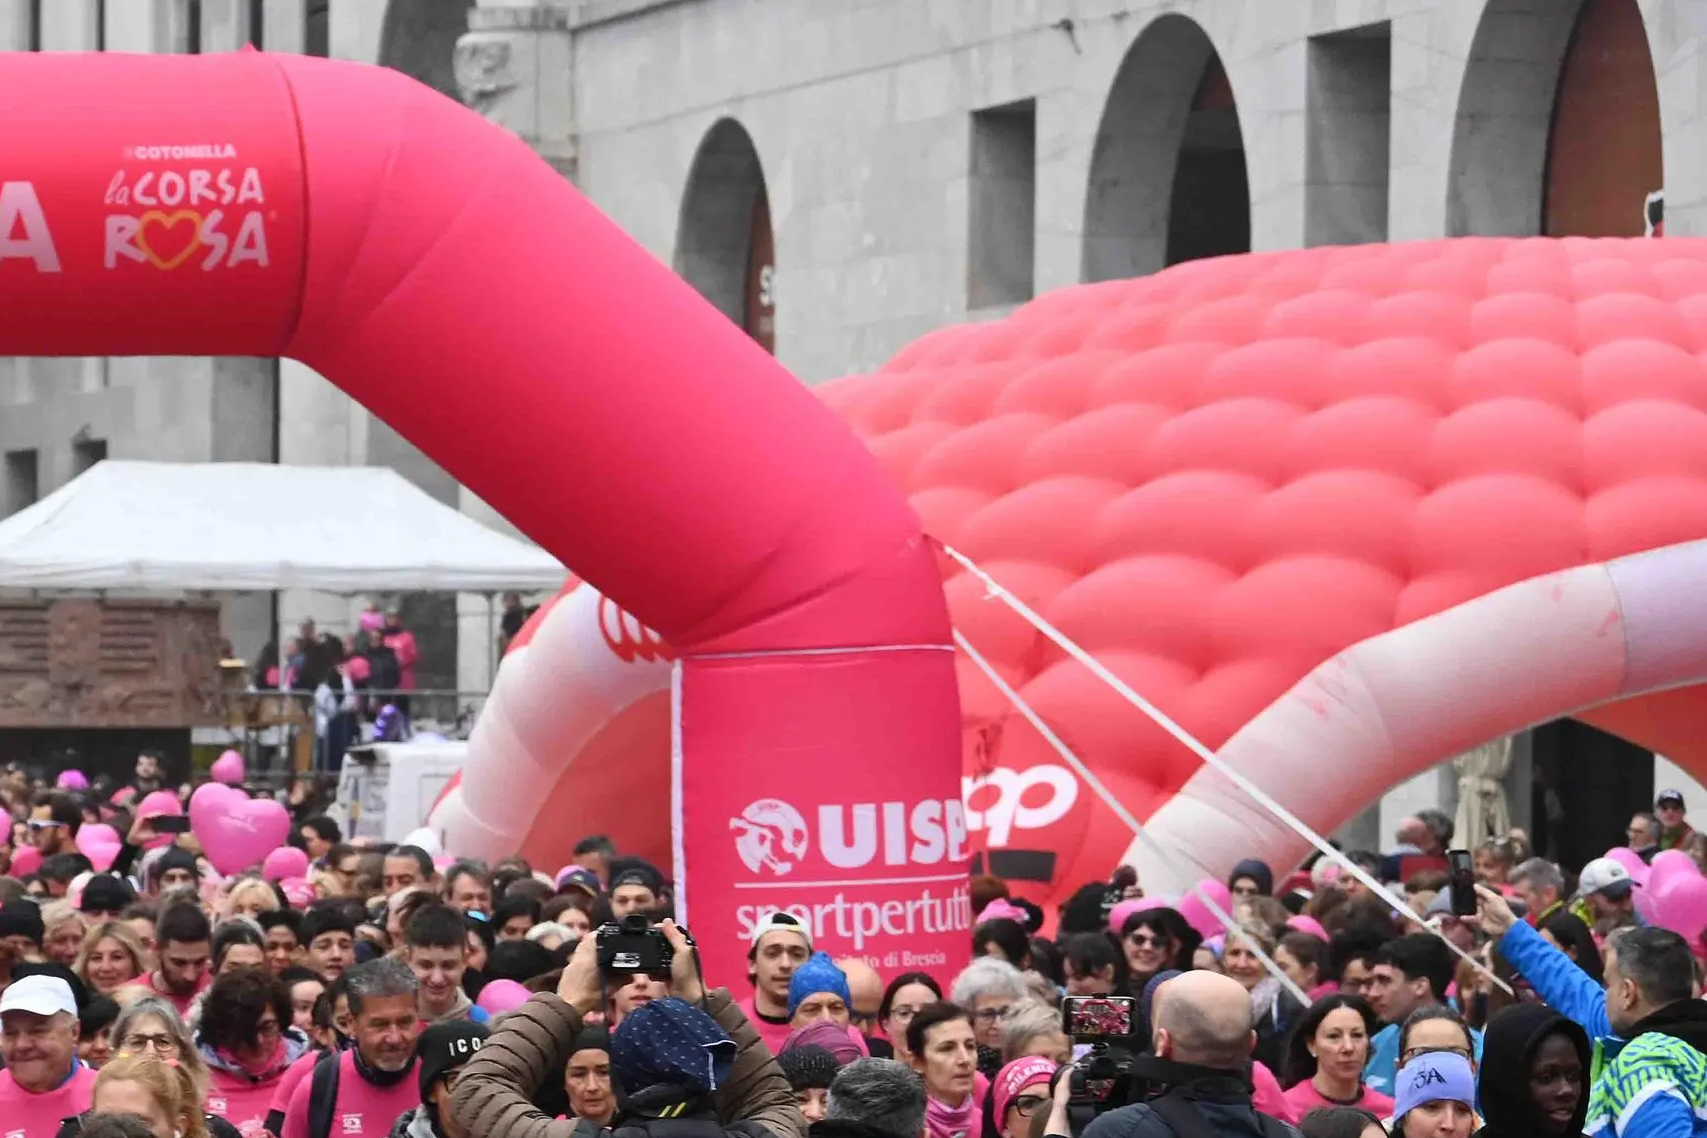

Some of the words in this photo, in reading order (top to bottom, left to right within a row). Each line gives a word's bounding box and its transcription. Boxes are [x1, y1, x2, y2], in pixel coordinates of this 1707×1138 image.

[135, 144, 237, 160] COTONELLA
[133, 167, 265, 208] CORSA
[818, 798, 968, 869] UISP
[902, 949, 946, 967] Brescia
[448, 1037, 485, 1057] ICO
